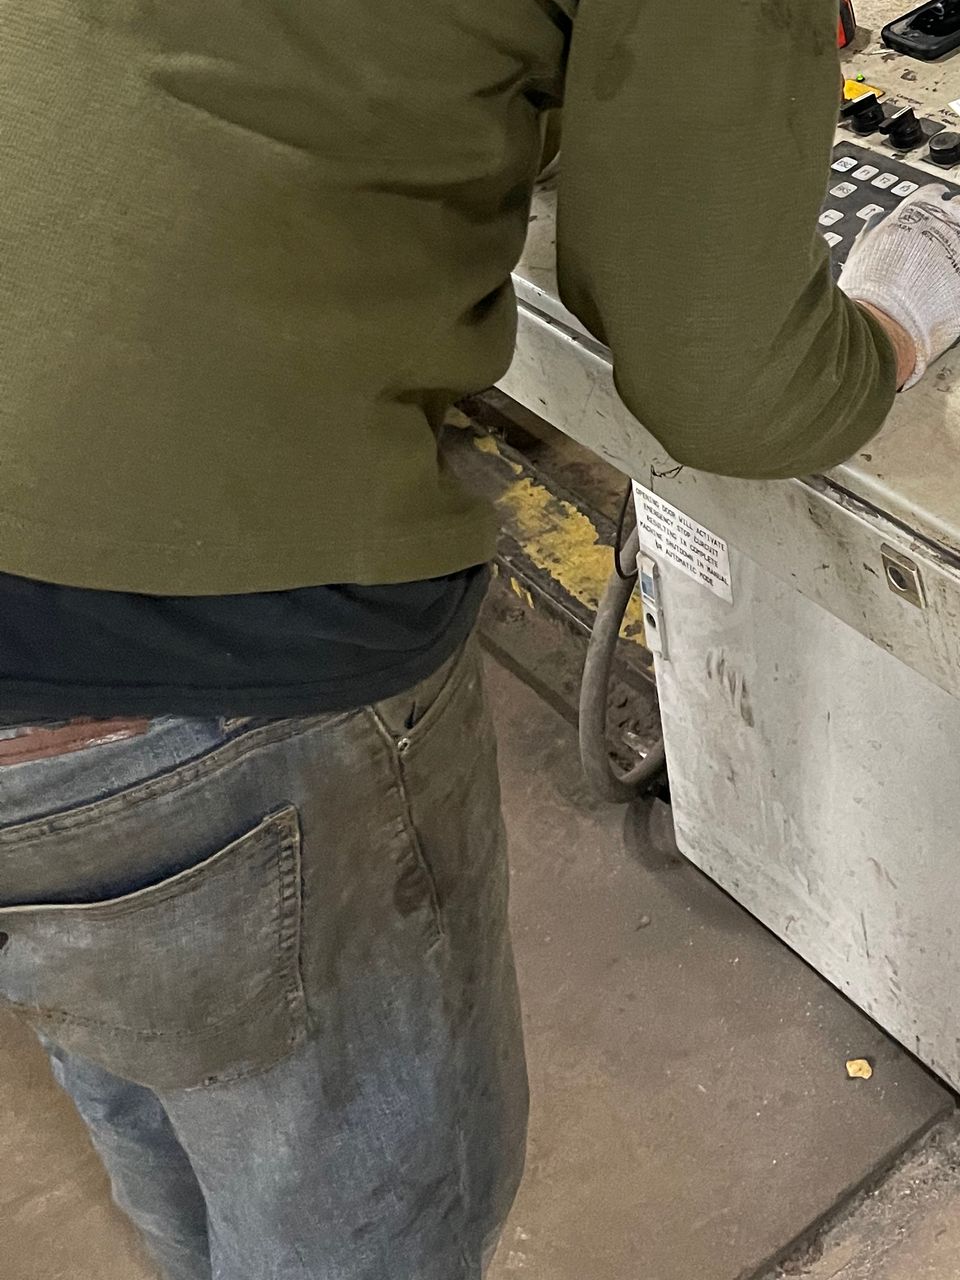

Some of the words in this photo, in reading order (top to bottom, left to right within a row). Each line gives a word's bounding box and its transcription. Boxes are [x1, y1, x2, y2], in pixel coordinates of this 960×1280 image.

[636, 487, 659, 508] OPENING
[662, 504, 676, 518] DOOR
[678, 515, 693, 531] WILL
[696, 527, 725, 552] ACTIVATE
[643, 502, 673, 526] EMERGENCY
[676, 525, 691, 538] STOP
[646, 514, 677, 541] RESULTING
[680, 537, 688, 547] IN
[689, 543, 718, 568] COMPLETE
[640, 520, 663, 541] MACHINE
[666, 538, 694, 562] SHUTDOWN
[696, 558, 704, 569] IN
[707, 566, 729, 586] MANUAL
[665, 549, 697, 575] AUTOMATIC
[699, 571, 714, 587] MODE
